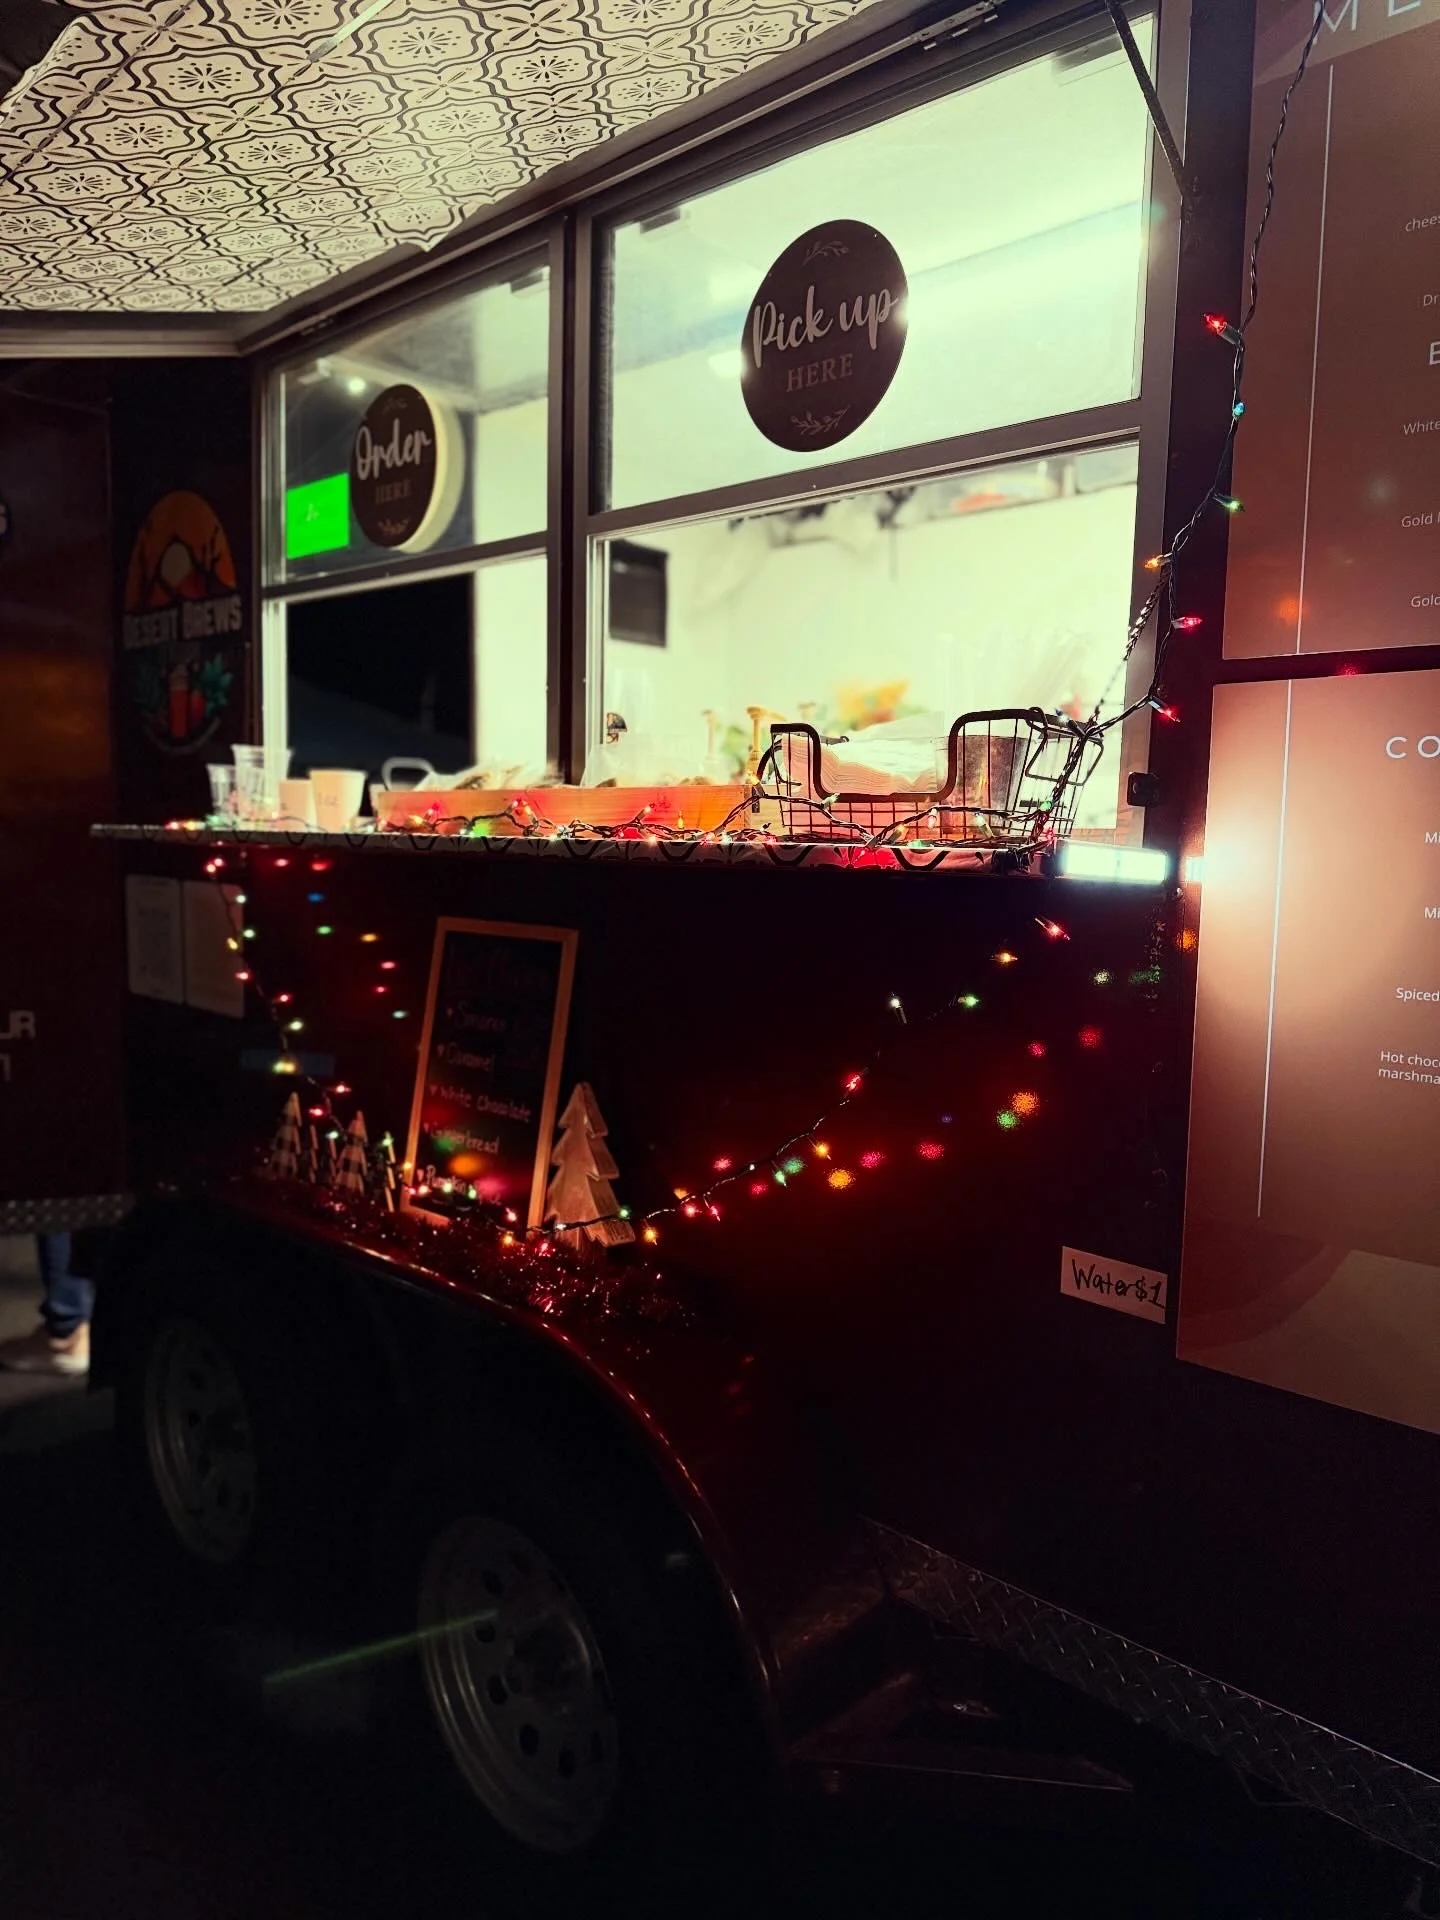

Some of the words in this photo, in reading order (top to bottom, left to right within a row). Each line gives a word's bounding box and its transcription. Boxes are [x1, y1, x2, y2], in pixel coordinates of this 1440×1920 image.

[752, 285, 834, 369] Pick
[839, 288, 899, 351] up
[786, 353, 854, 393] HERE
[355, 417, 432, 481] Order
[1402, 511, 1433, 528] Gold
[1396, 987, 1440, 1002] Spiced
[1380, 1050, 1404, 1064] Hot
[1407, 1053, 1440, 1068] choc
